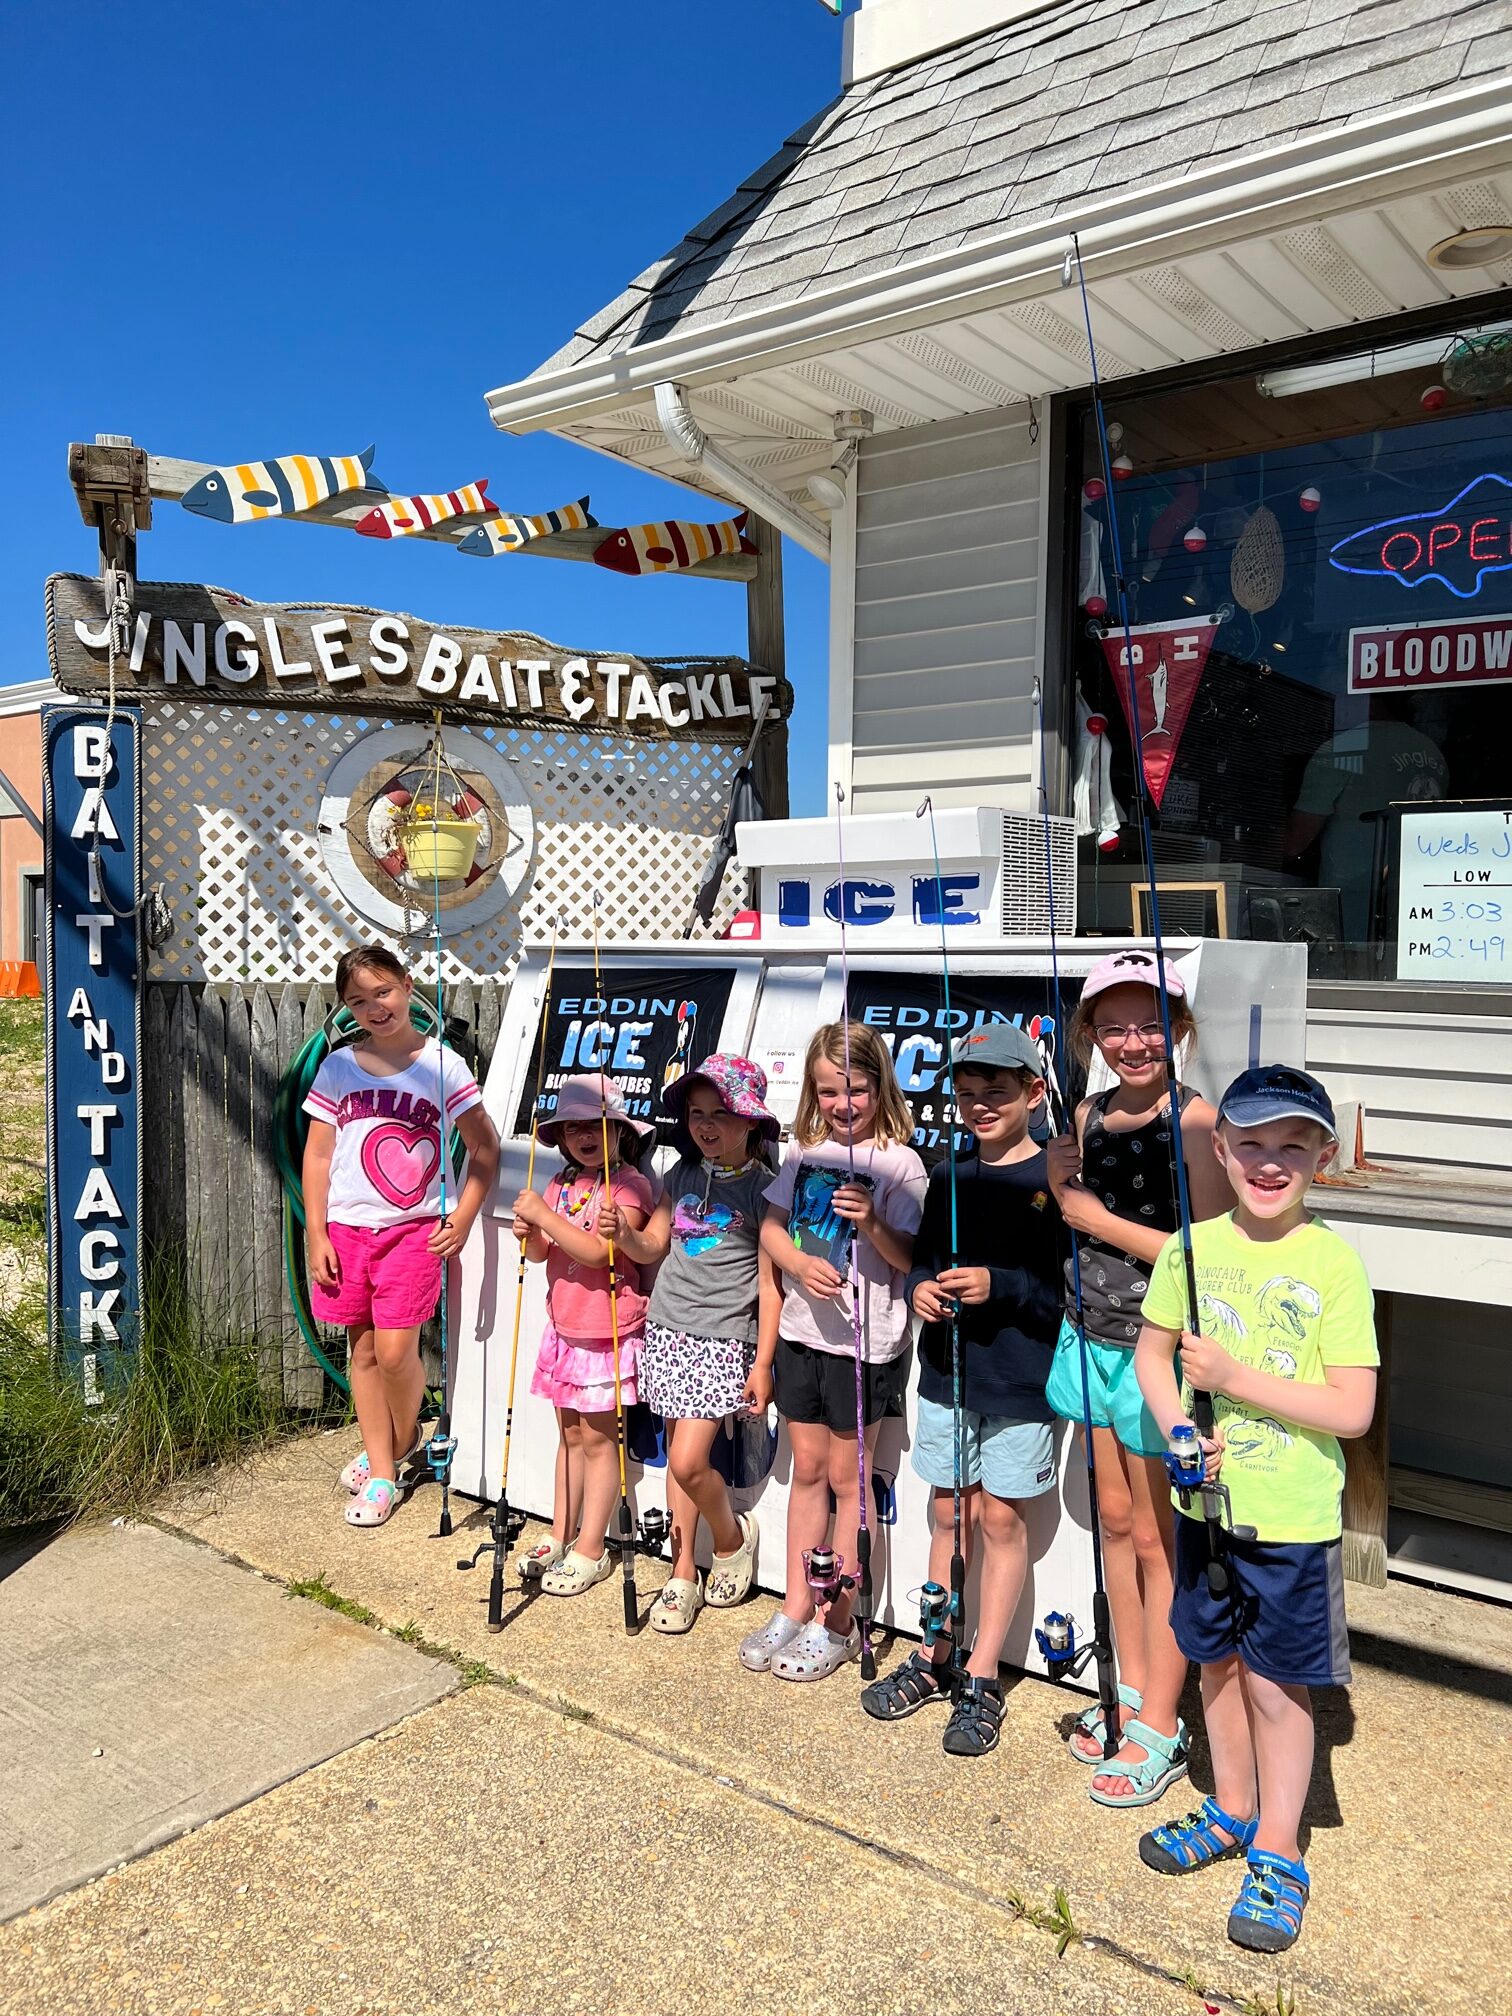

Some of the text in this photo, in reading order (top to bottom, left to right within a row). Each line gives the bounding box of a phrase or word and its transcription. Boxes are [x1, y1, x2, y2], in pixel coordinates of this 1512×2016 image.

[1381, 518, 1512, 571] OPE
[416, 633, 551, 708] BAIT
[560, 657, 595, 722] &
[597, 661, 781, 727] TACKLE
[70, 725, 119, 965] BAIT
[1417, 832, 1480, 857] Weds
[1453, 870, 1491, 882] LOW
[777, 872, 982, 927] ICE
[1409, 901, 1503, 922] AM 3:03
[1409, 936, 1505, 961] PM 2:49
[558, 998, 676, 1016] EDDIN
[863, 1006, 1023, 1029] EDDIN
[67, 987, 125, 1083] AND
[559, 1020, 654, 1070] ICE
[1256, 1086, 1290, 1094] Jackson
[920, 1103, 934, 1121] &
[74, 1105, 121, 1428] TACKL
[1196, 1266, 1247, 1281] DINOSAUR
[1227, 1282, 1253, 1294] CLUB
[1239, 1461, 1279, 1473] CARNIVORE
